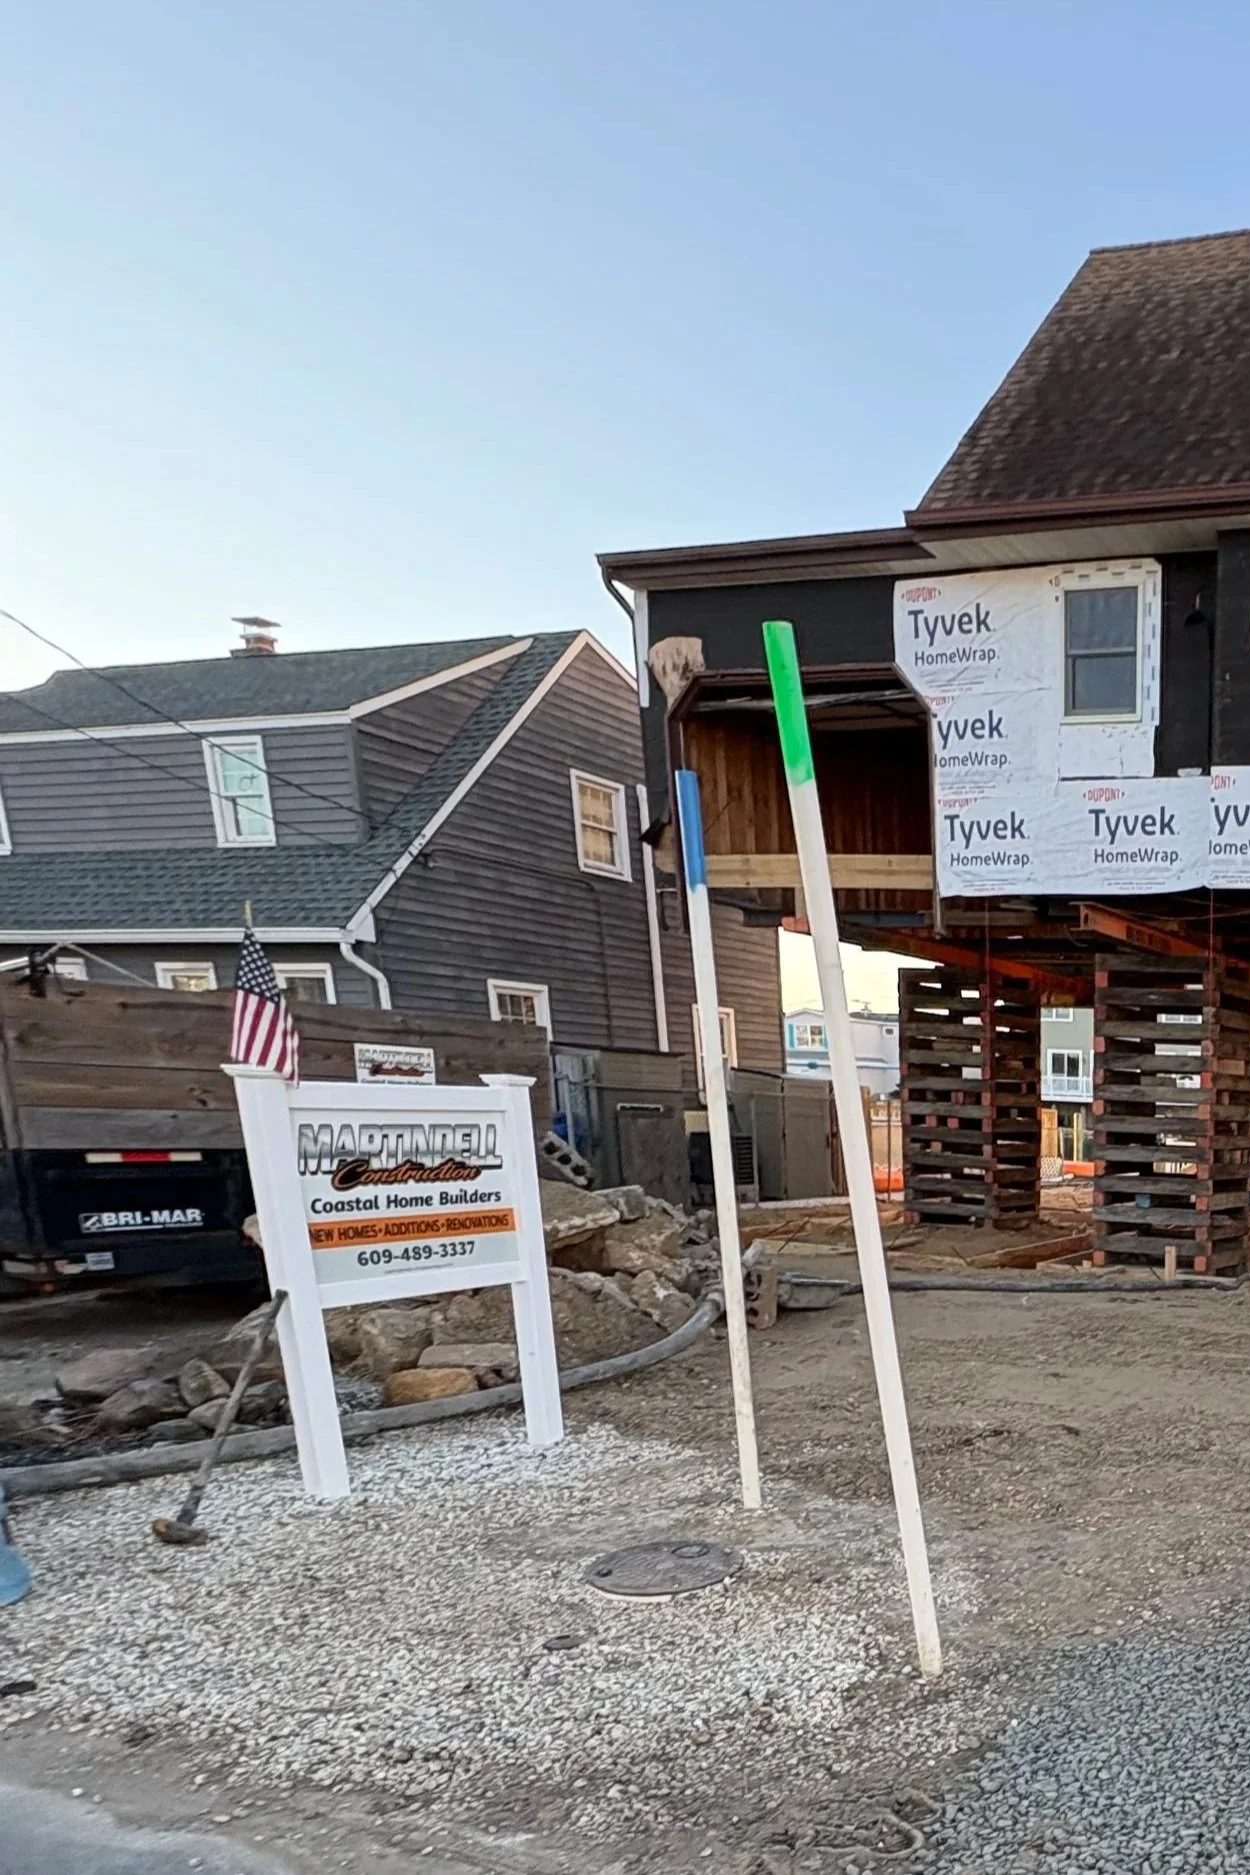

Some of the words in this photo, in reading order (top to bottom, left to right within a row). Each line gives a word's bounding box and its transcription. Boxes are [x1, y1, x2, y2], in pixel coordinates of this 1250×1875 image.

[906, 587, 937, 602] DUPONT
[908, 603, 992, 647] Tyvek
[914, 647, 996, 666] HomeWrap
[932, 710, 1003, 750] yvek
[1087, 788, 1121, 802] DUPONT
[944, 811, 1026, 849] Tyvek
[1088, 806, 1176, 845] Tyvek
[950, 851, 1029, 868] HomeWrap
[1094, 848, 1179, 865] HomeWrap
[298, 1124, 503, 1176] MARTINDELL
[331, 1158, 483, 1192] Construction
[311, 1194, 380, 1214] Coastal
[386, 1194, 433, 1209] Home
[439, 1188, 502, 1205] Builders
[101, 1208, 202, 1227] BRI-MAR
[309, 1227, 334, 1243] NEW
[337, 1223, 379, 1240] HOMES
[384, 1218, 441, 1236] ADDITIONS
[446, 1214, 510, 1231] RENOVATIONS
[357, 1241, 476, 1267] 609-489-3337
